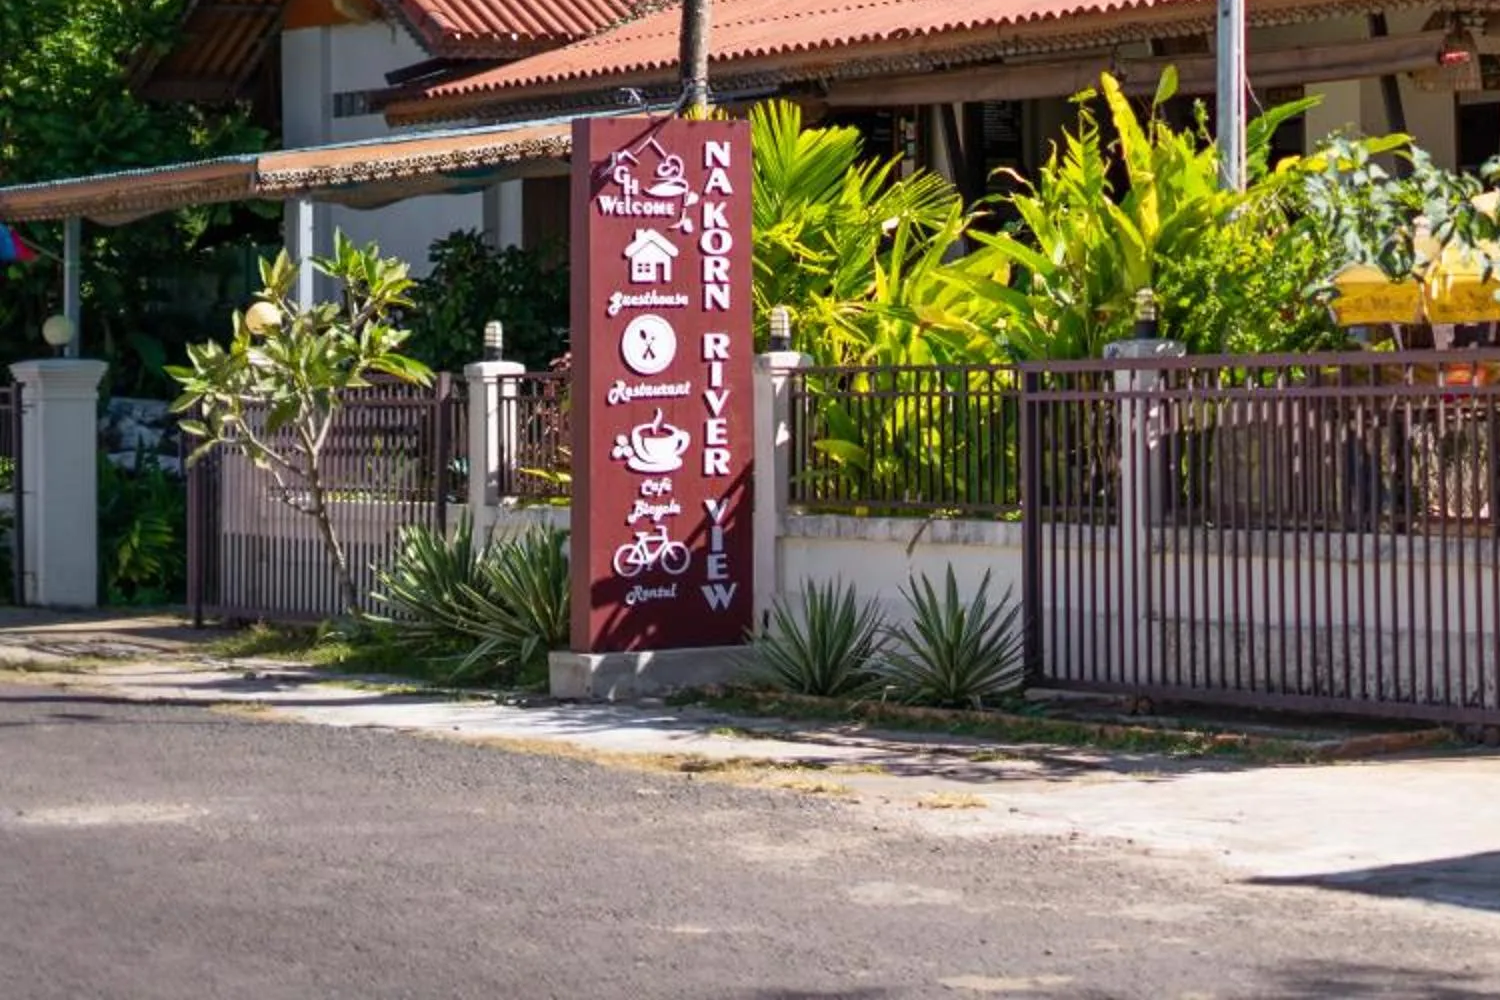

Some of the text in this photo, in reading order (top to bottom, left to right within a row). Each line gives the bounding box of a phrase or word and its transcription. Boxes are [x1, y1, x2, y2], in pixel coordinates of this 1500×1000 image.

[701, 140, 736, 611] NAKORN RIVER VIEW
[608, 380, 691, 405] Restaurant
[628, 498, 681, 524] Bicycle
[625, 583, 678, 605] Rental
